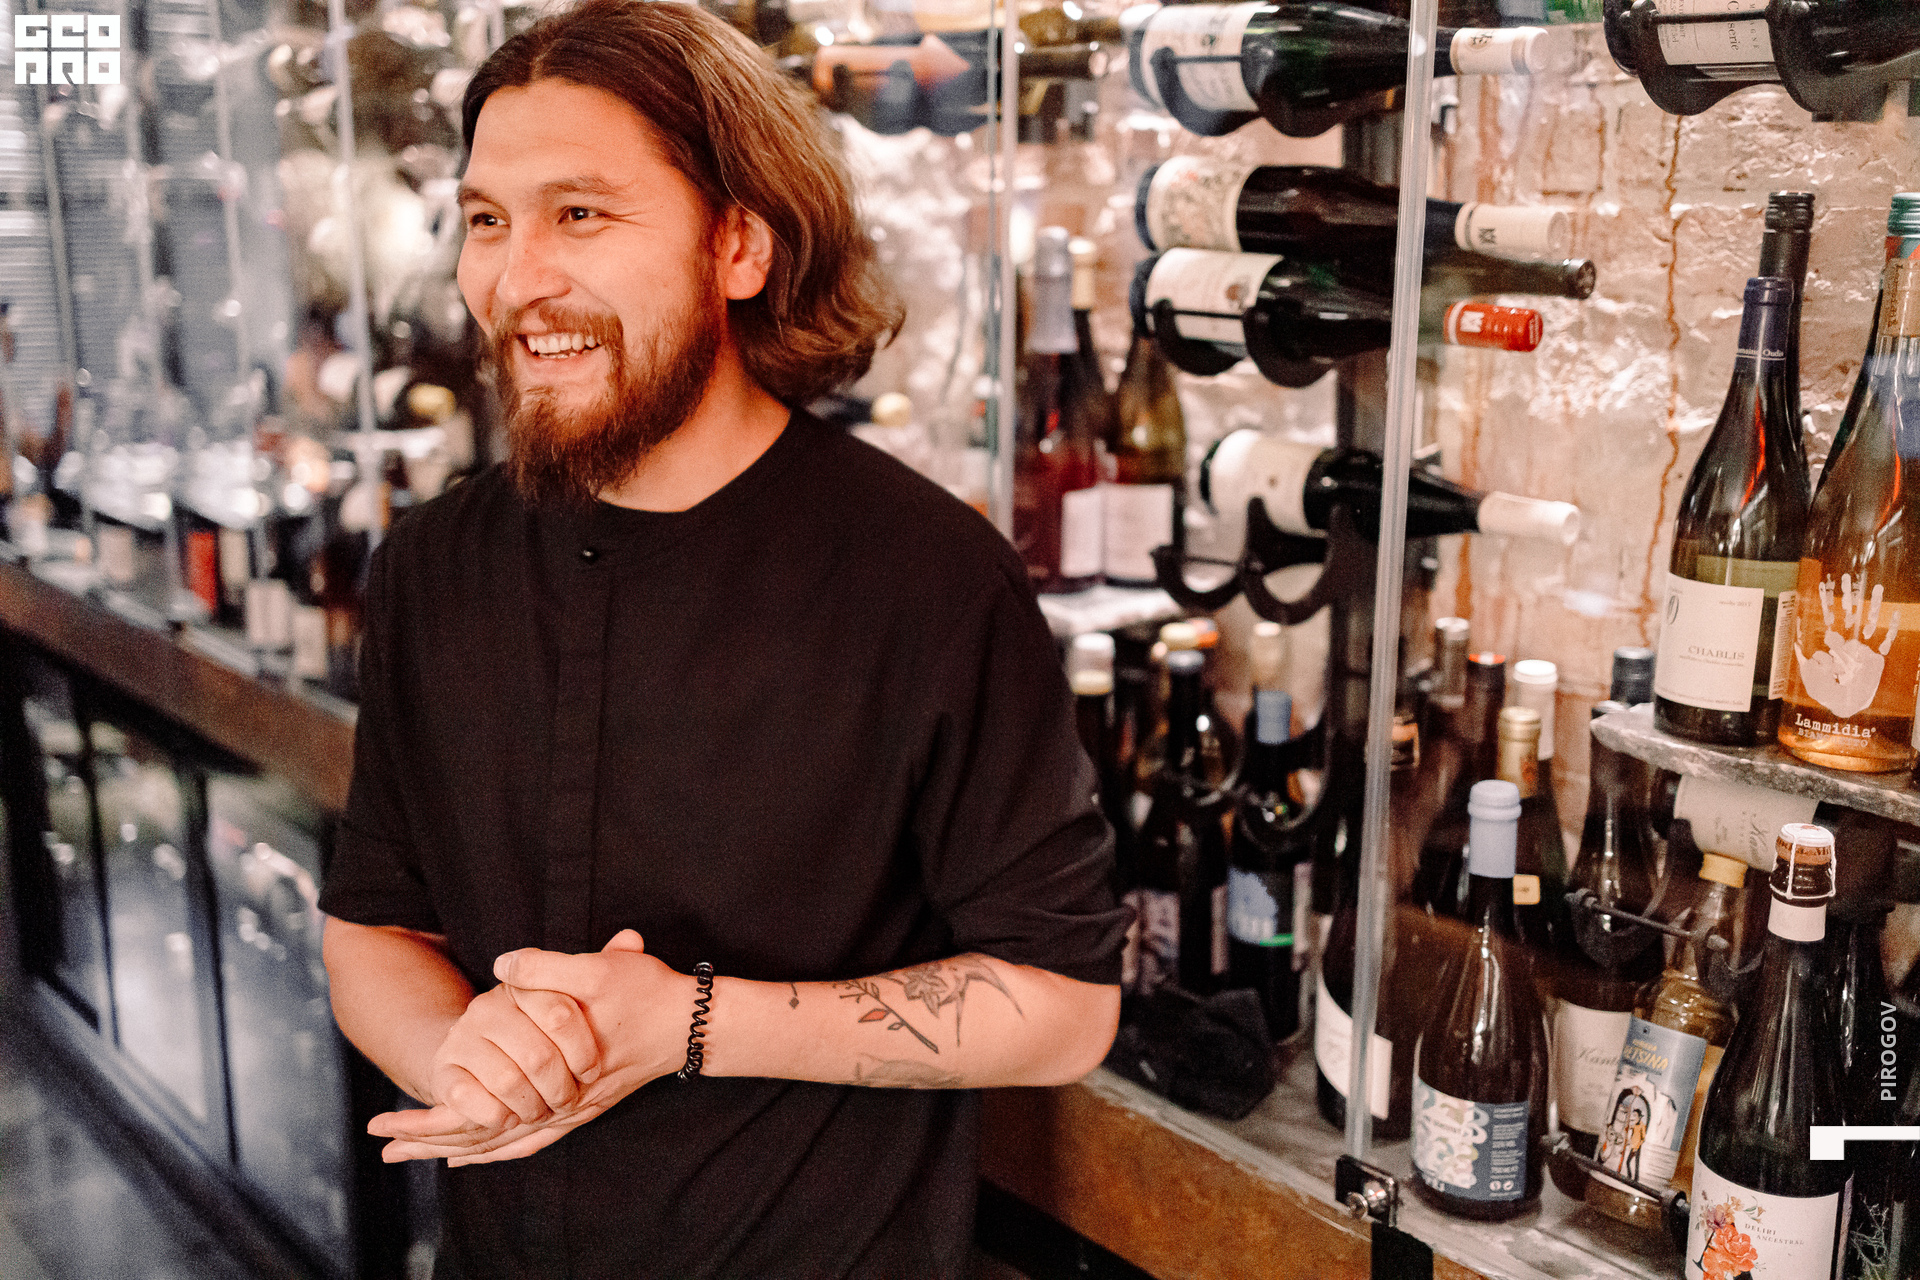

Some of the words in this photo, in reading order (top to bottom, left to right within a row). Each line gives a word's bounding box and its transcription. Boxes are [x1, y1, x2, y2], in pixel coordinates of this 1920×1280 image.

[1688, 645, 1745, 660] CHABLIS
[1795, 712, 1872, 738] Lammidia
[1744, 1223, 1776, 1236] DELIRI
[1756, 1234, 1804, 1245] ANCESTRAL
